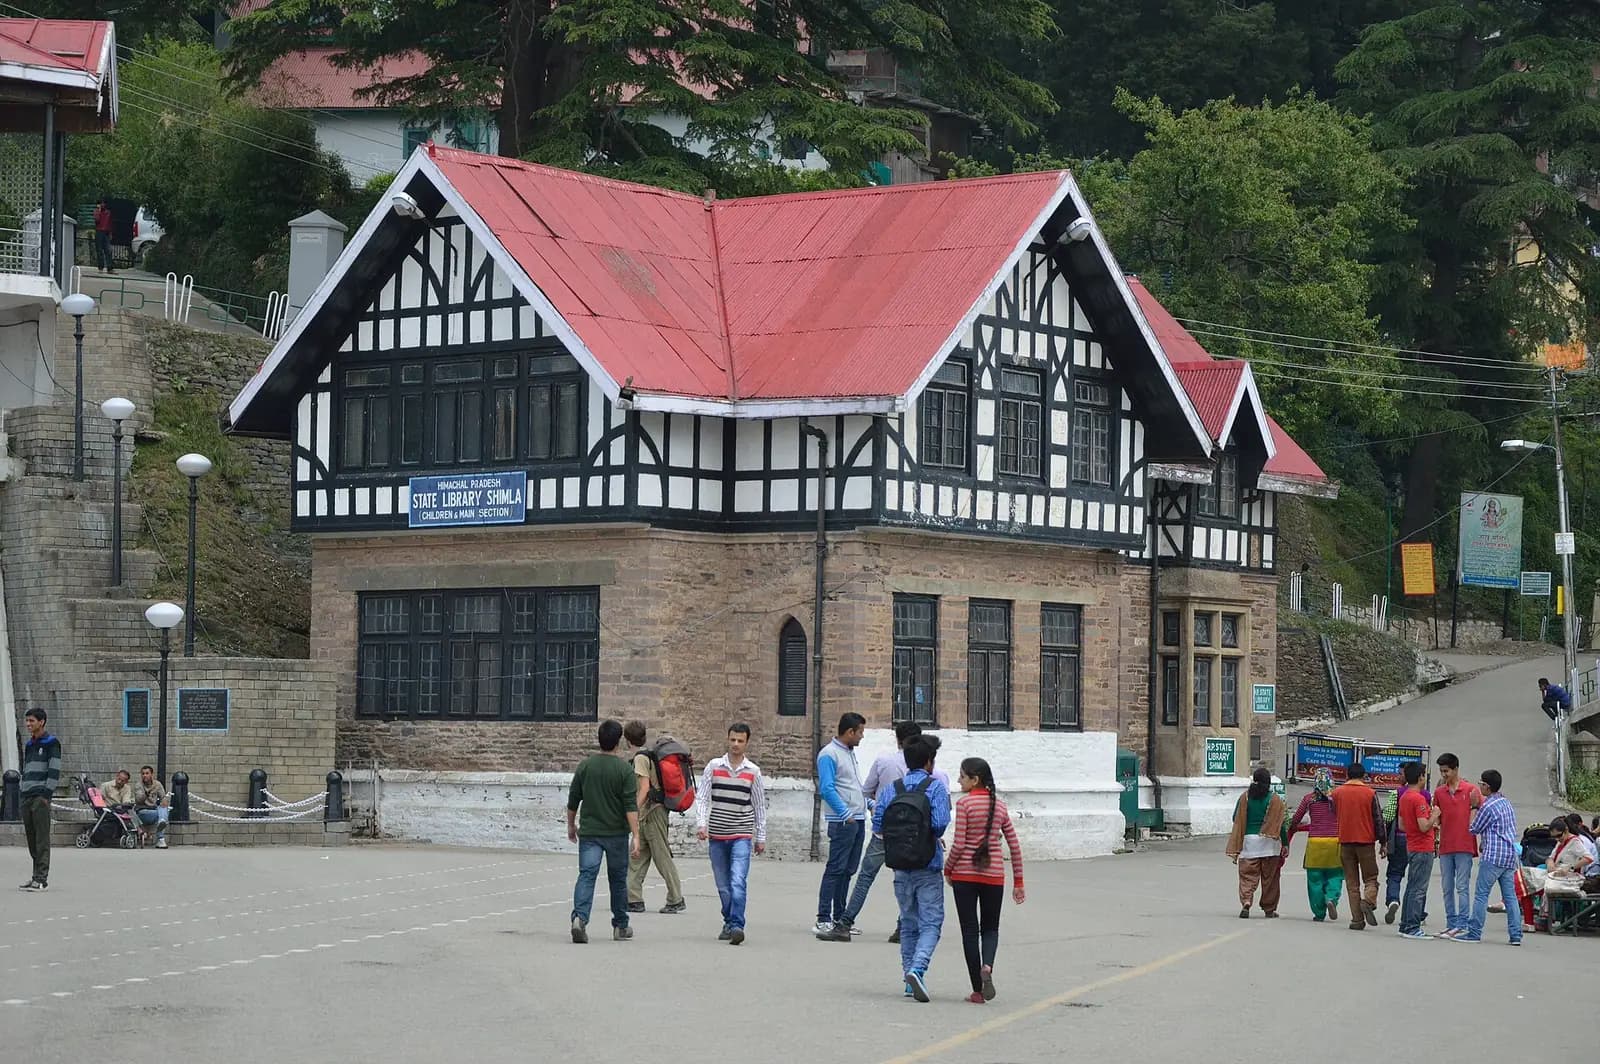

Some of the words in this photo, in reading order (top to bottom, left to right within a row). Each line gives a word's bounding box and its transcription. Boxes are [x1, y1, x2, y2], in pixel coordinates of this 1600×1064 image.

[437, 481, 468, 491] HIMACHAL
[470, 478, 501, 489] PRADESH
[412, 492, 438, 509] STATE
[442, 490, 482, 508] LIBRARY
[486, 488, 522, 506] SHIMLA
[459, 509, 475, 518] MAIN
[1322, 739, 1338, 748] TRAFFIC
[1338, 741, 1353, 749] POLICE
[1208, 752, 1230, 761] LIBRARY
[1209, 761, 1227, 770] SHIMLA
